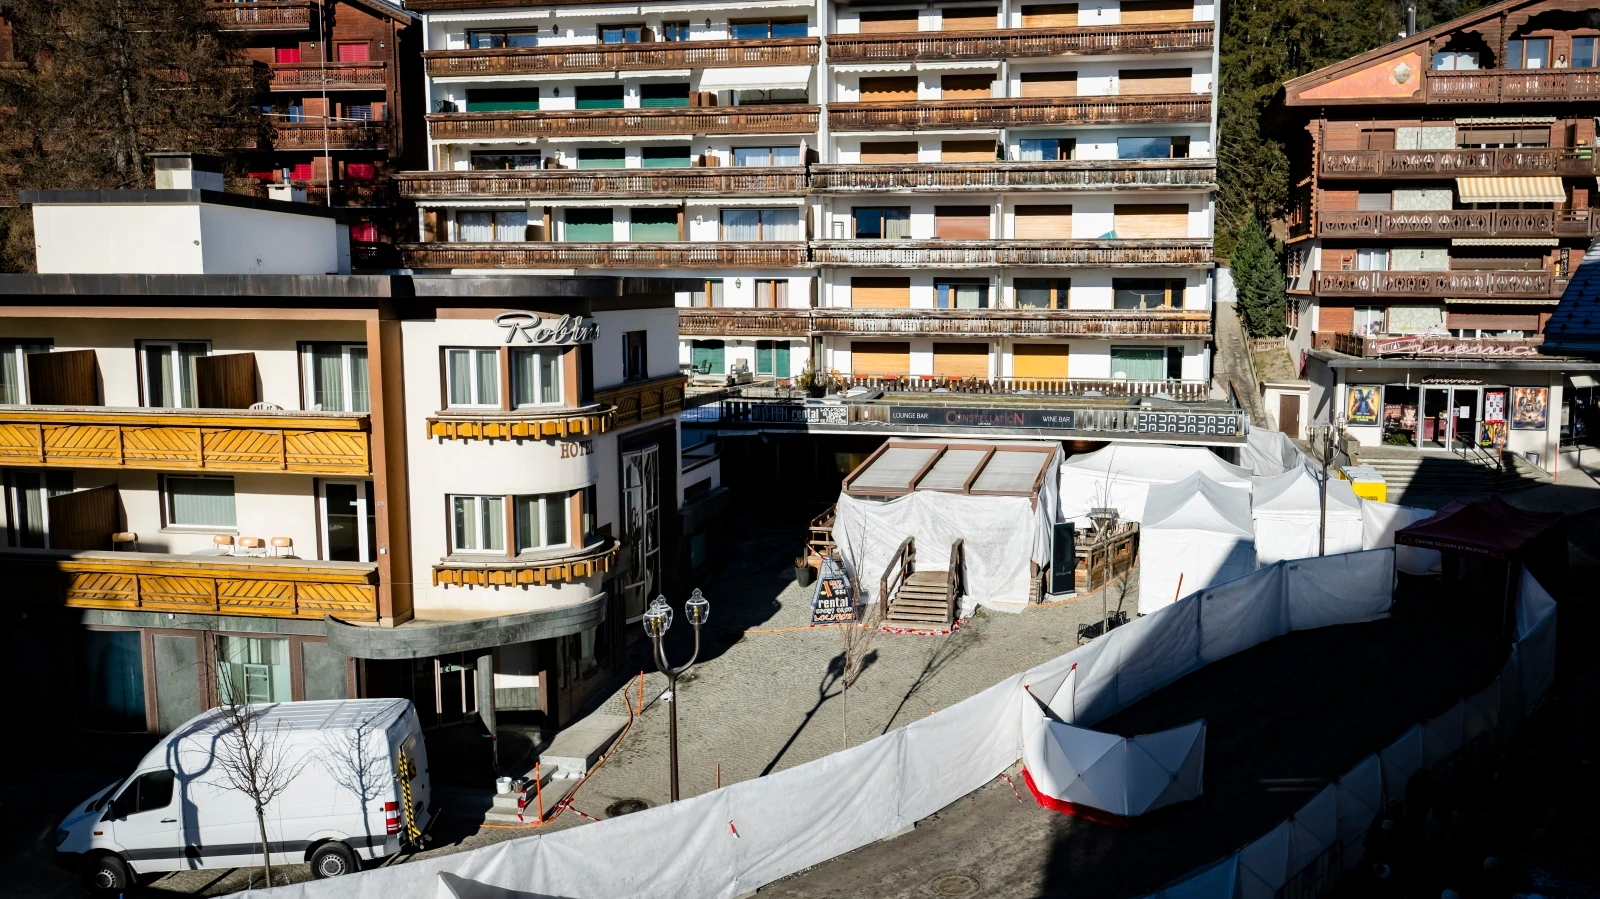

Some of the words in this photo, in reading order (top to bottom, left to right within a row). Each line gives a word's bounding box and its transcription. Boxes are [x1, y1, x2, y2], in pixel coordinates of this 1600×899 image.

[792, 407, 818, 418] rental
[1042, 414, 1058, 423] WINE
[1058, 414, 1071, 423] BAR
[560, 439, 593, 459] HOTEL
[1414, 538, 1434, 546] CENTRE
[1434, 541, 1457, 549] SECOURS
[818, 597, 849, 608] rental
